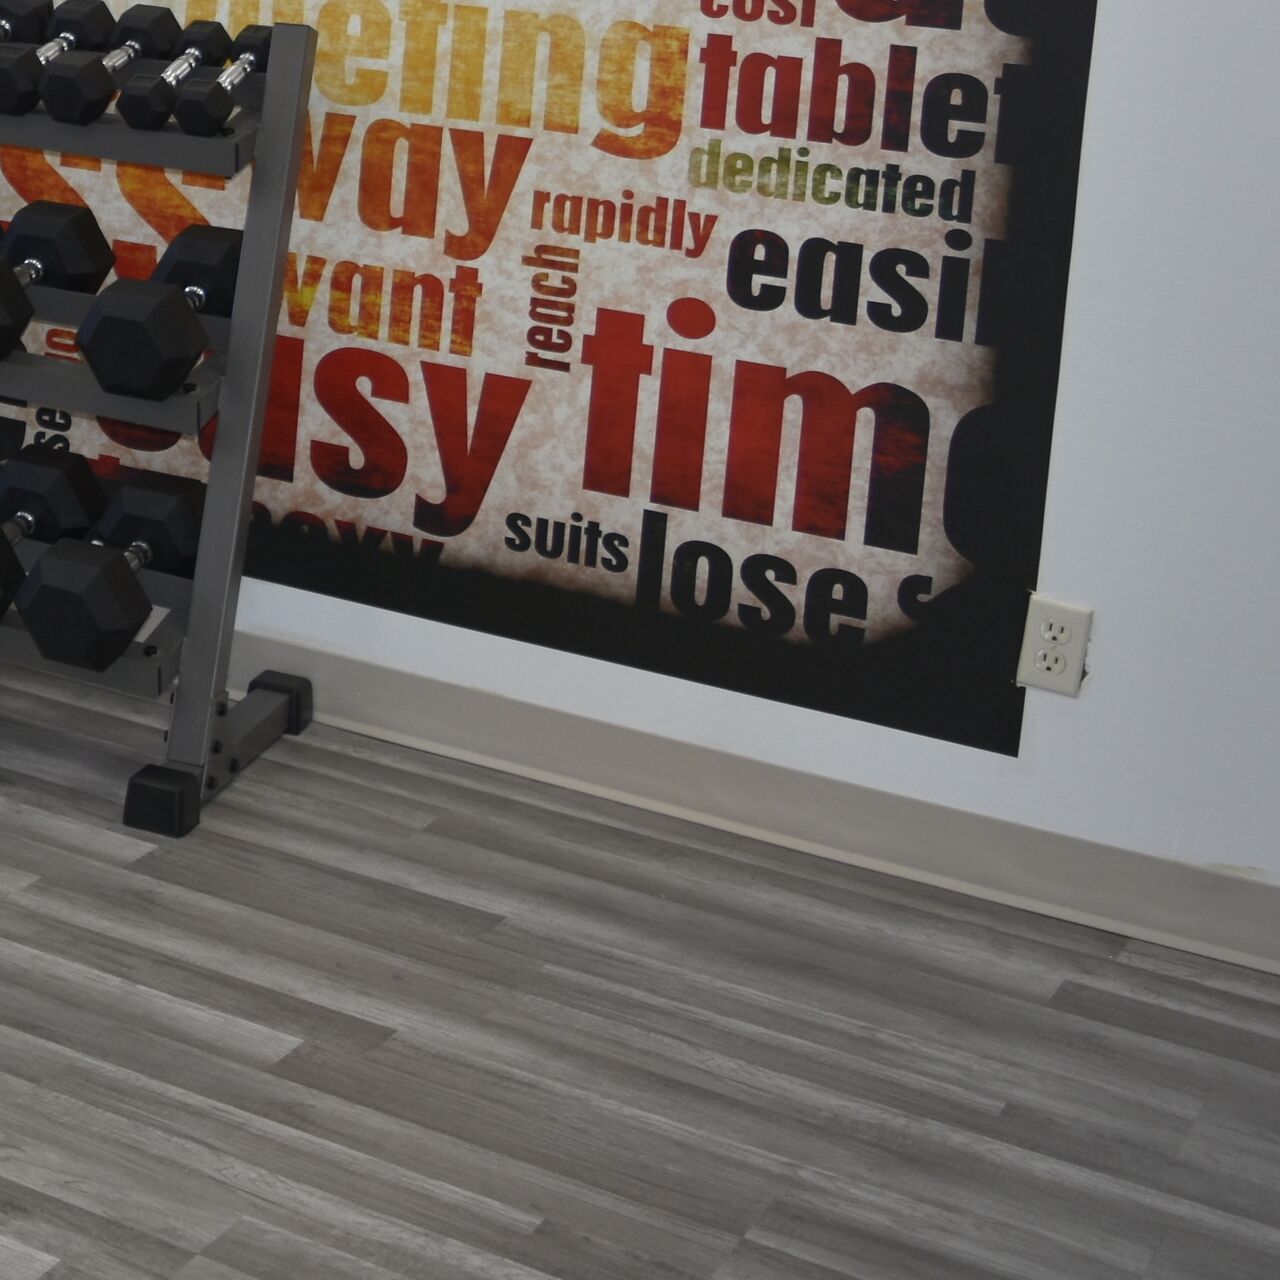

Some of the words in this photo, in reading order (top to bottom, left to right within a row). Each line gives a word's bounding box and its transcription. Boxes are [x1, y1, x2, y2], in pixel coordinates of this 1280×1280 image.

[688, 138, 976, 223] dedicated
[530, 189, 718, 259] rapidly
[521, 243, 581, 373] reach
[504, 511, 630, 574] suits
[636, 508, 869, 646] lose
